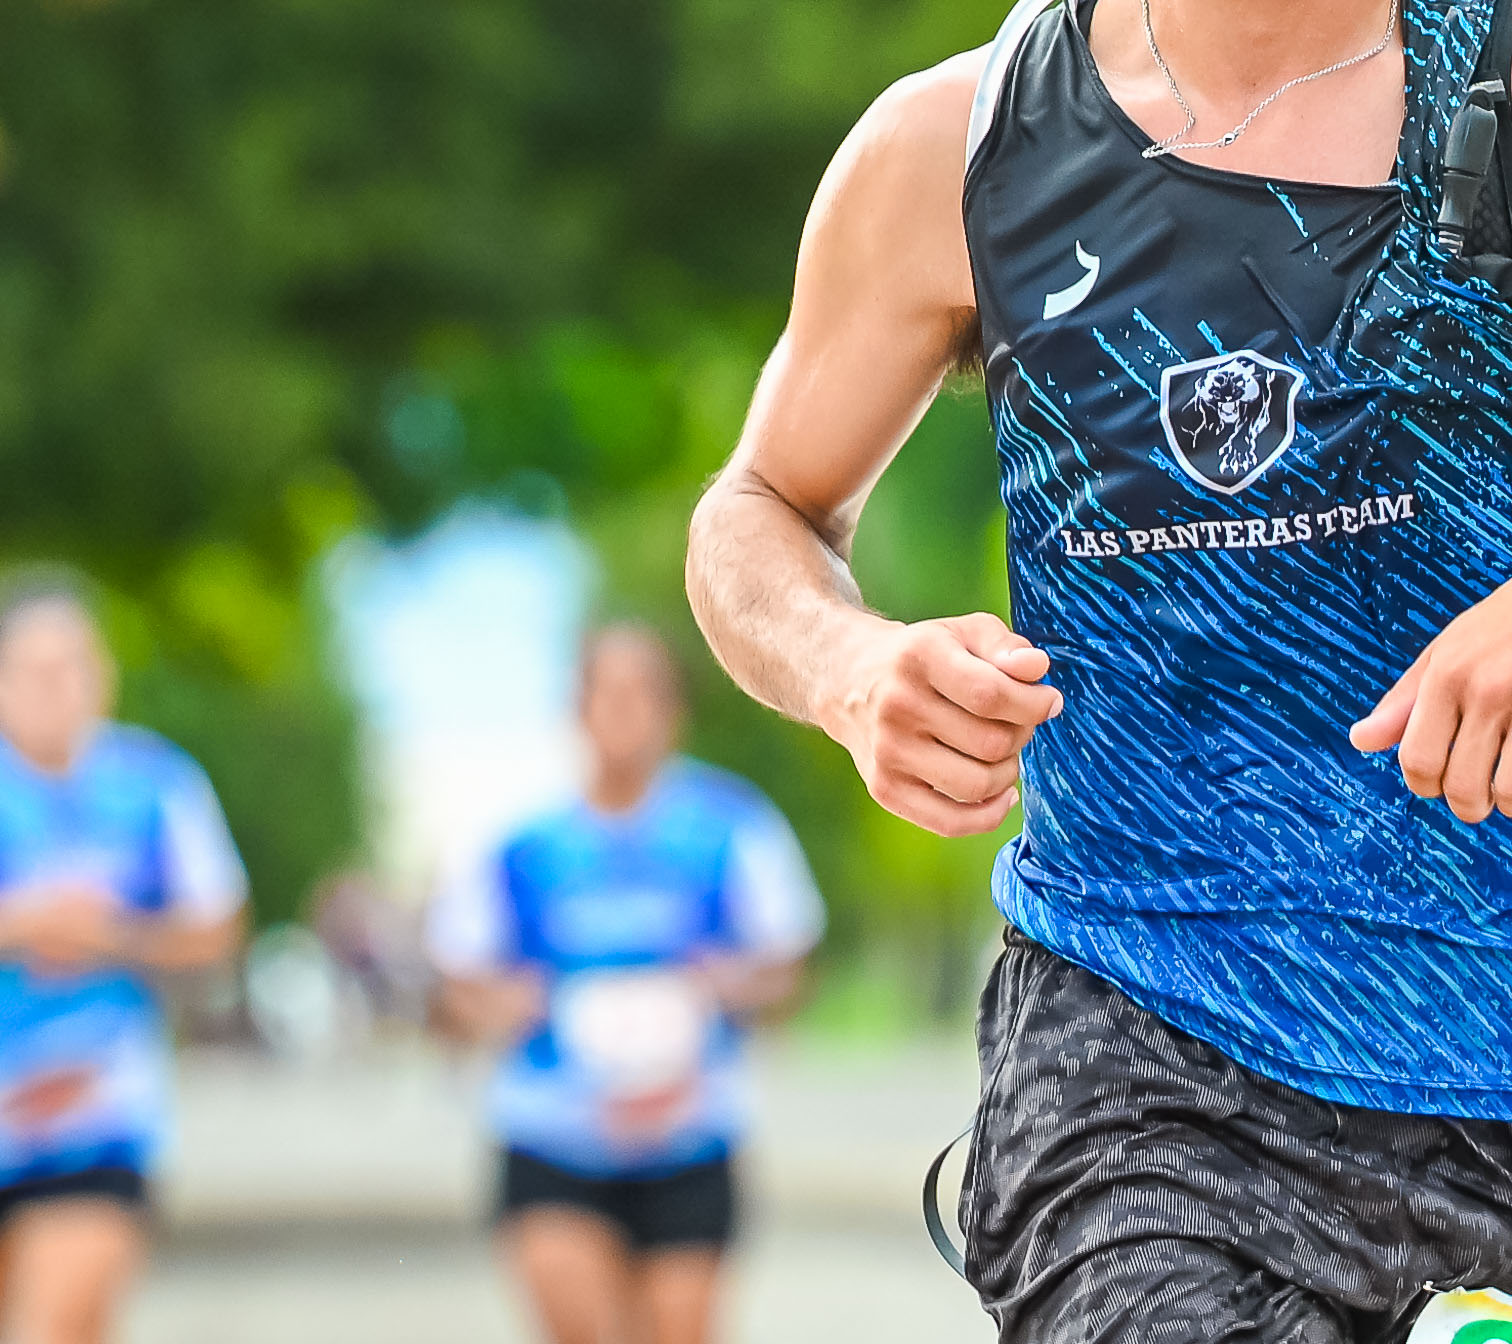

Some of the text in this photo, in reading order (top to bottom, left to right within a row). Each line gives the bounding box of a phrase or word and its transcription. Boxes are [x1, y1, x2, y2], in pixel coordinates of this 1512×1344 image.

[1061, 494, 1415, 557] LAS PANTERAS TEAM
